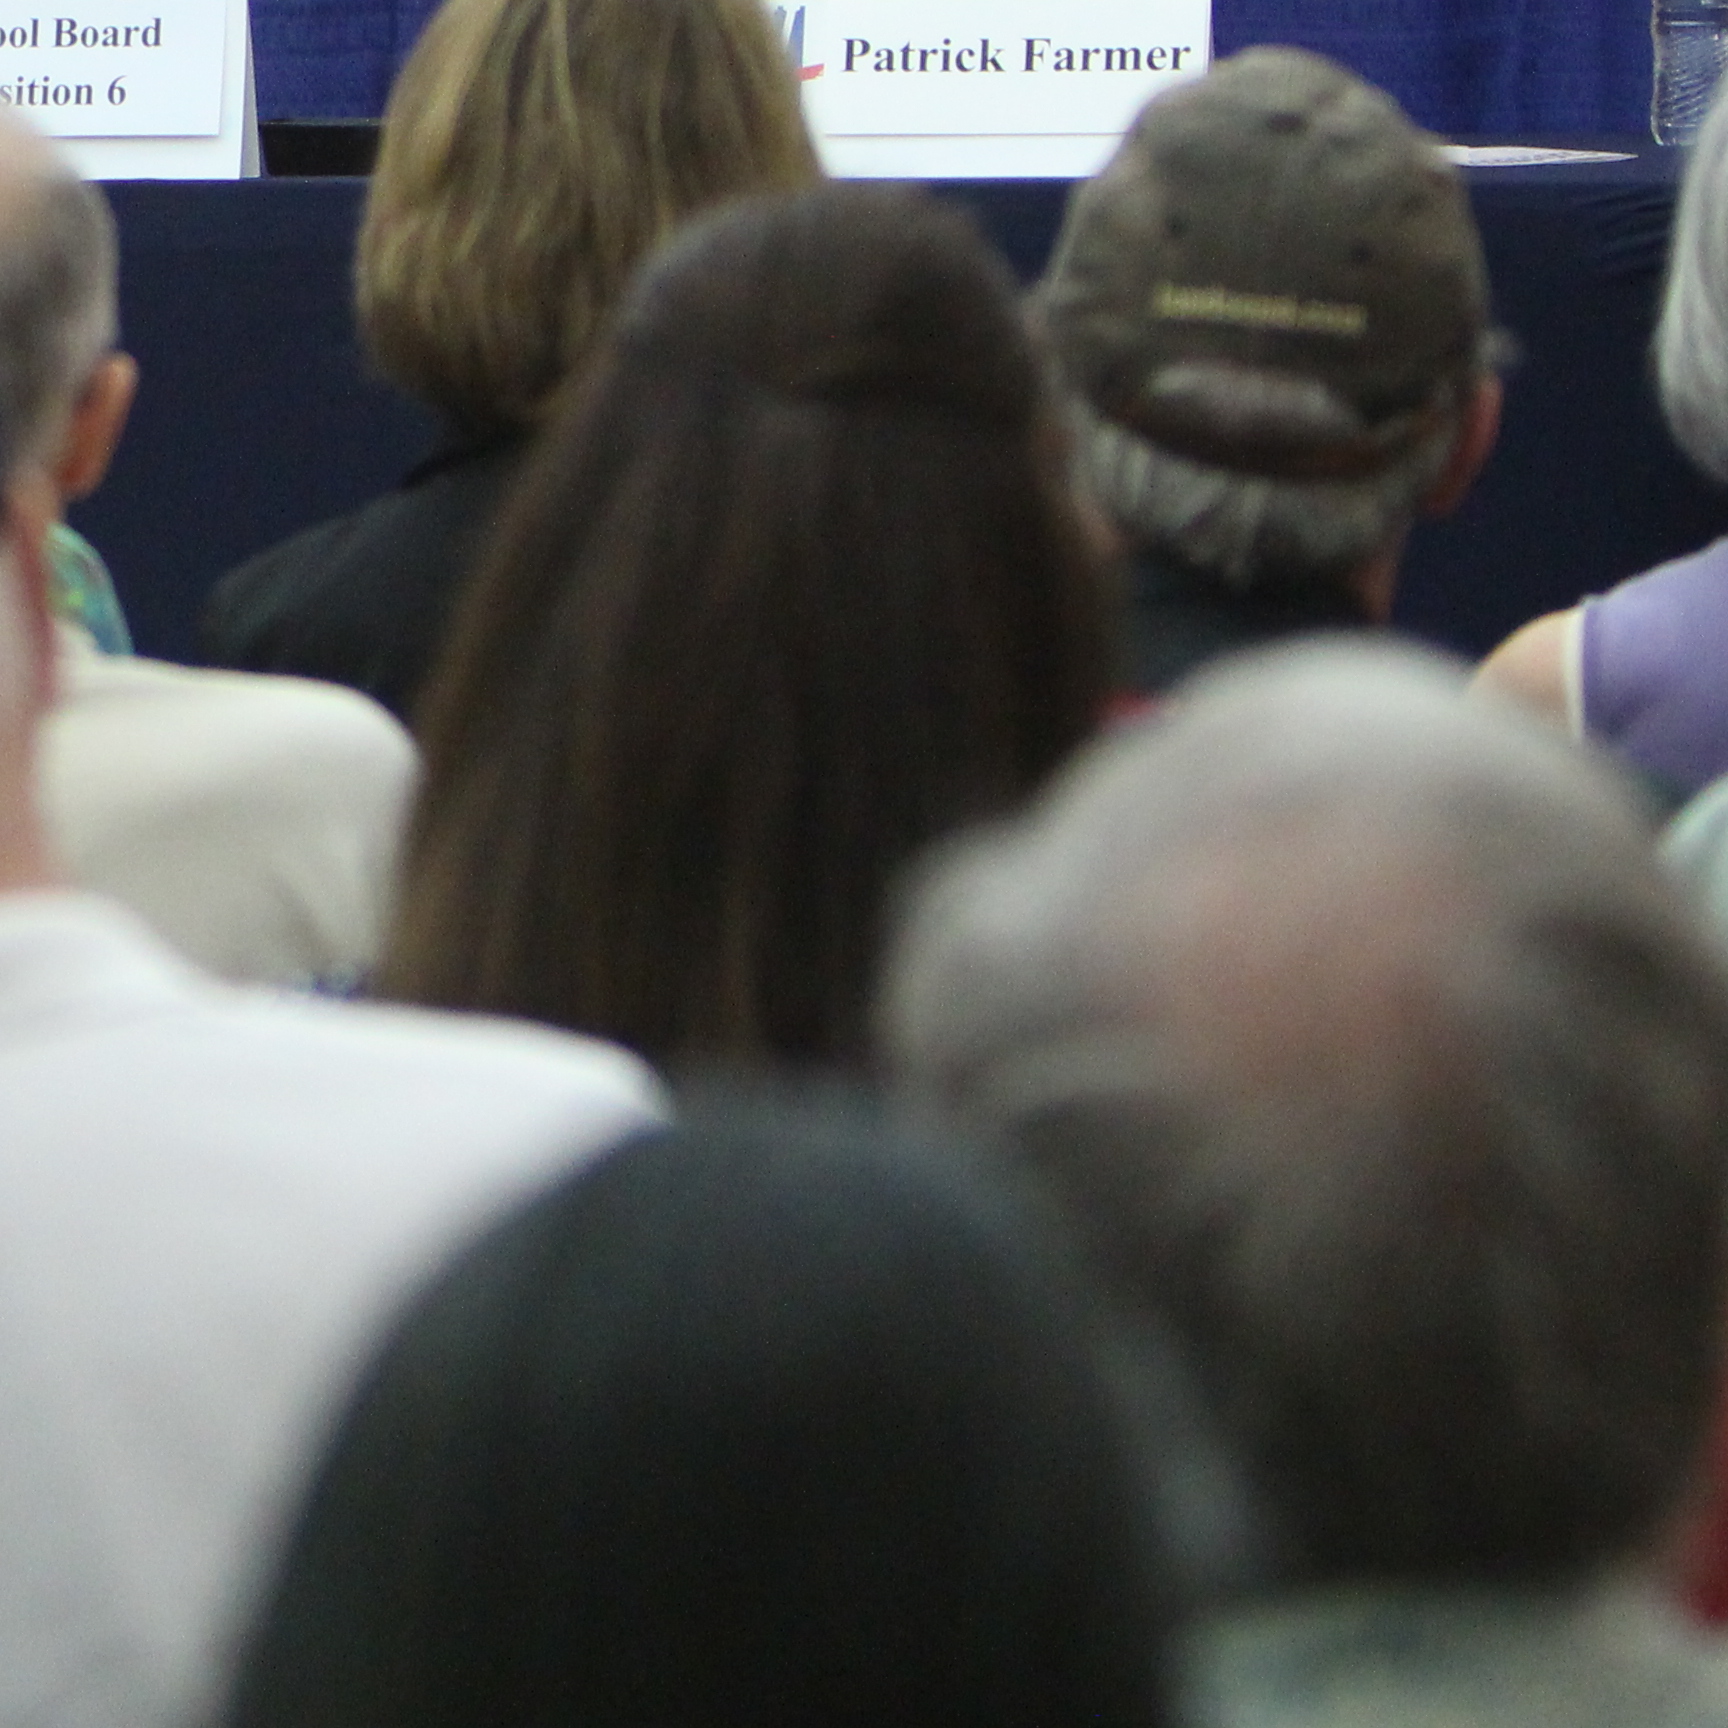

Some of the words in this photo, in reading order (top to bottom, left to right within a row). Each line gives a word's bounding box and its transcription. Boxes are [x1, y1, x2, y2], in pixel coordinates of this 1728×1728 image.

[52, 17, 164, 48] Board
[842, 37, 1006, 73] Patrick
[1023, 36, 1192, 72] Farmer
[106, 75, 128, 106] 6
